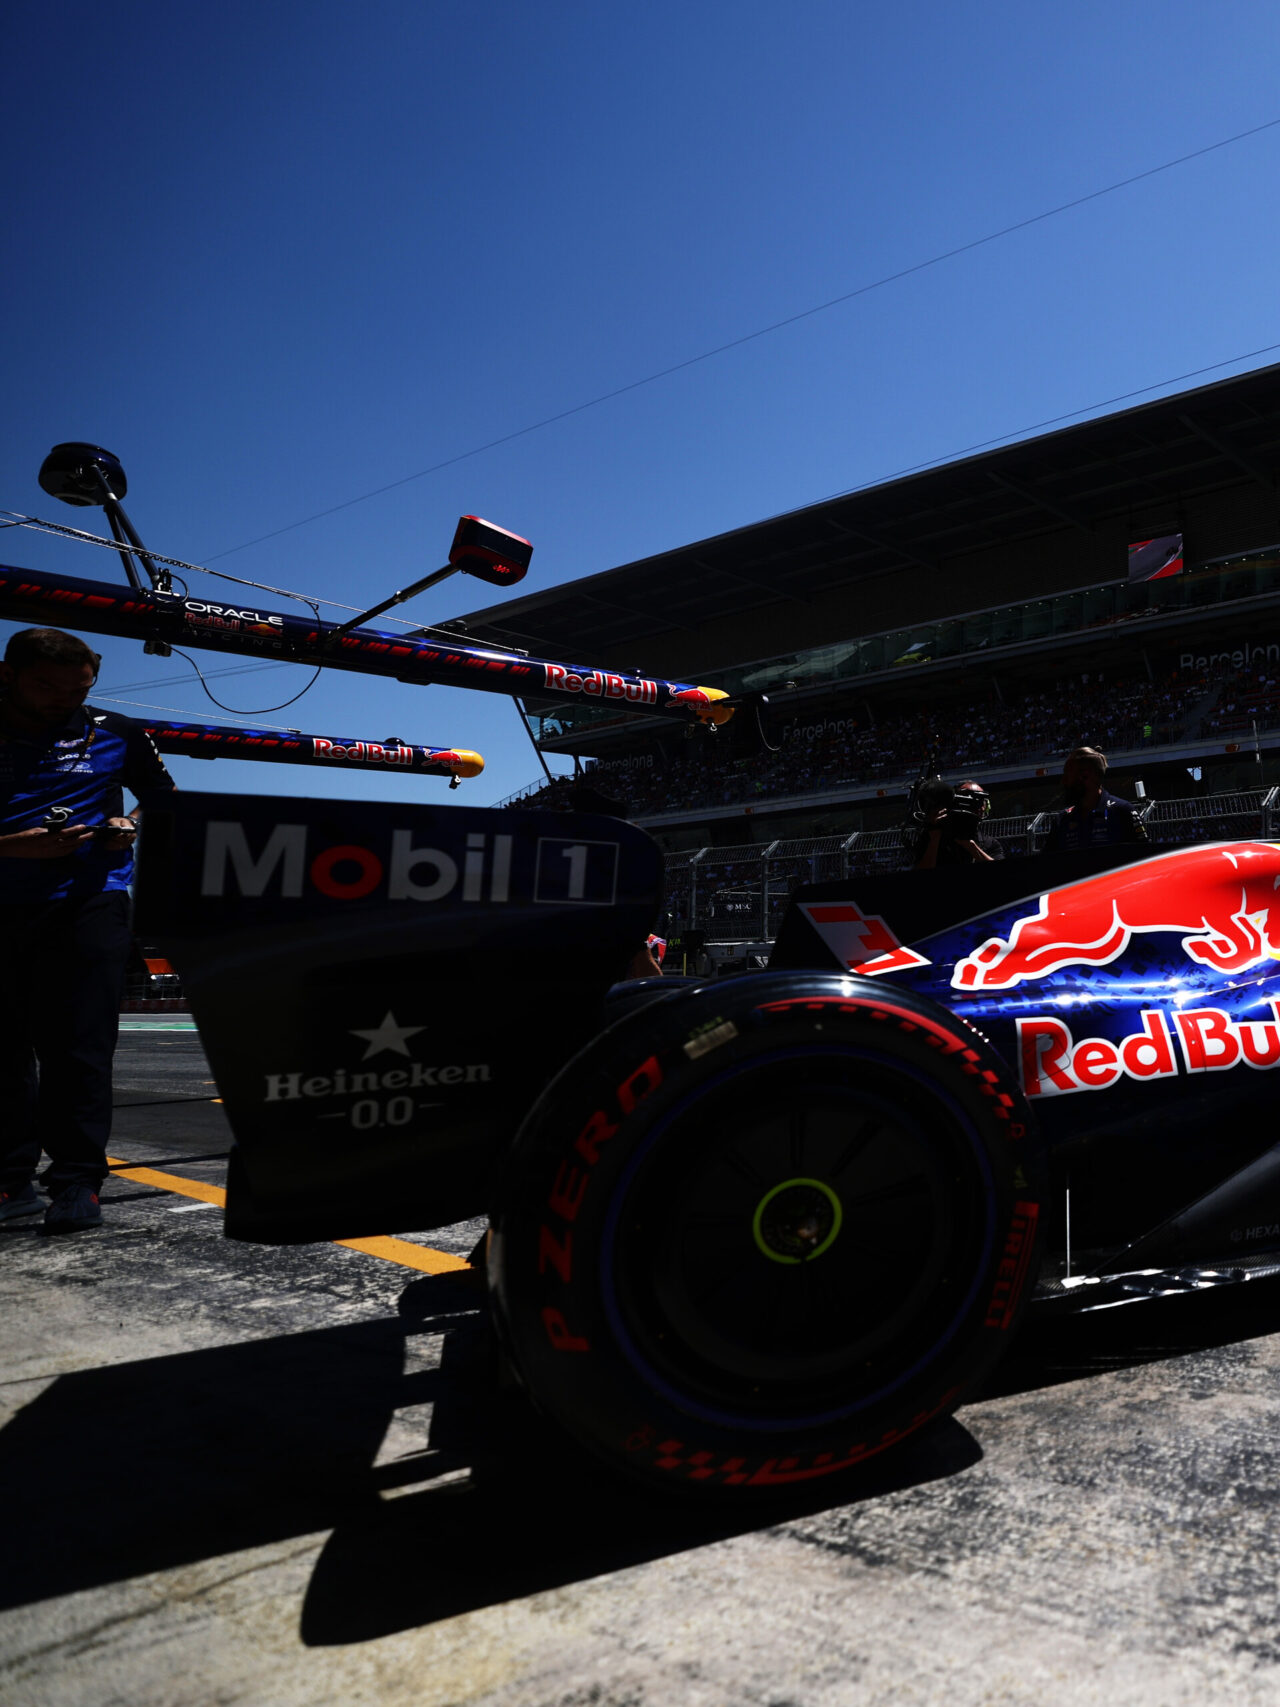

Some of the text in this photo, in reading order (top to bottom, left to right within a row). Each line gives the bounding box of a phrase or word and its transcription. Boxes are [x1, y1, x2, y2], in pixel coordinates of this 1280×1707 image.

[185, 602, 284, 626] ORACLE
[185, 612, 240, 632] Red Bull
[544, 663, 657, 704] Red Bull
[312, 738, 413, 765] Red Bull
[200, 821, 590, 901] Mobil 1
[1018, 1010, 1176, 1097] Red
[264, 1062, 492, 1104] Heineken
[537, 1055, 664, 1284] ZERO
